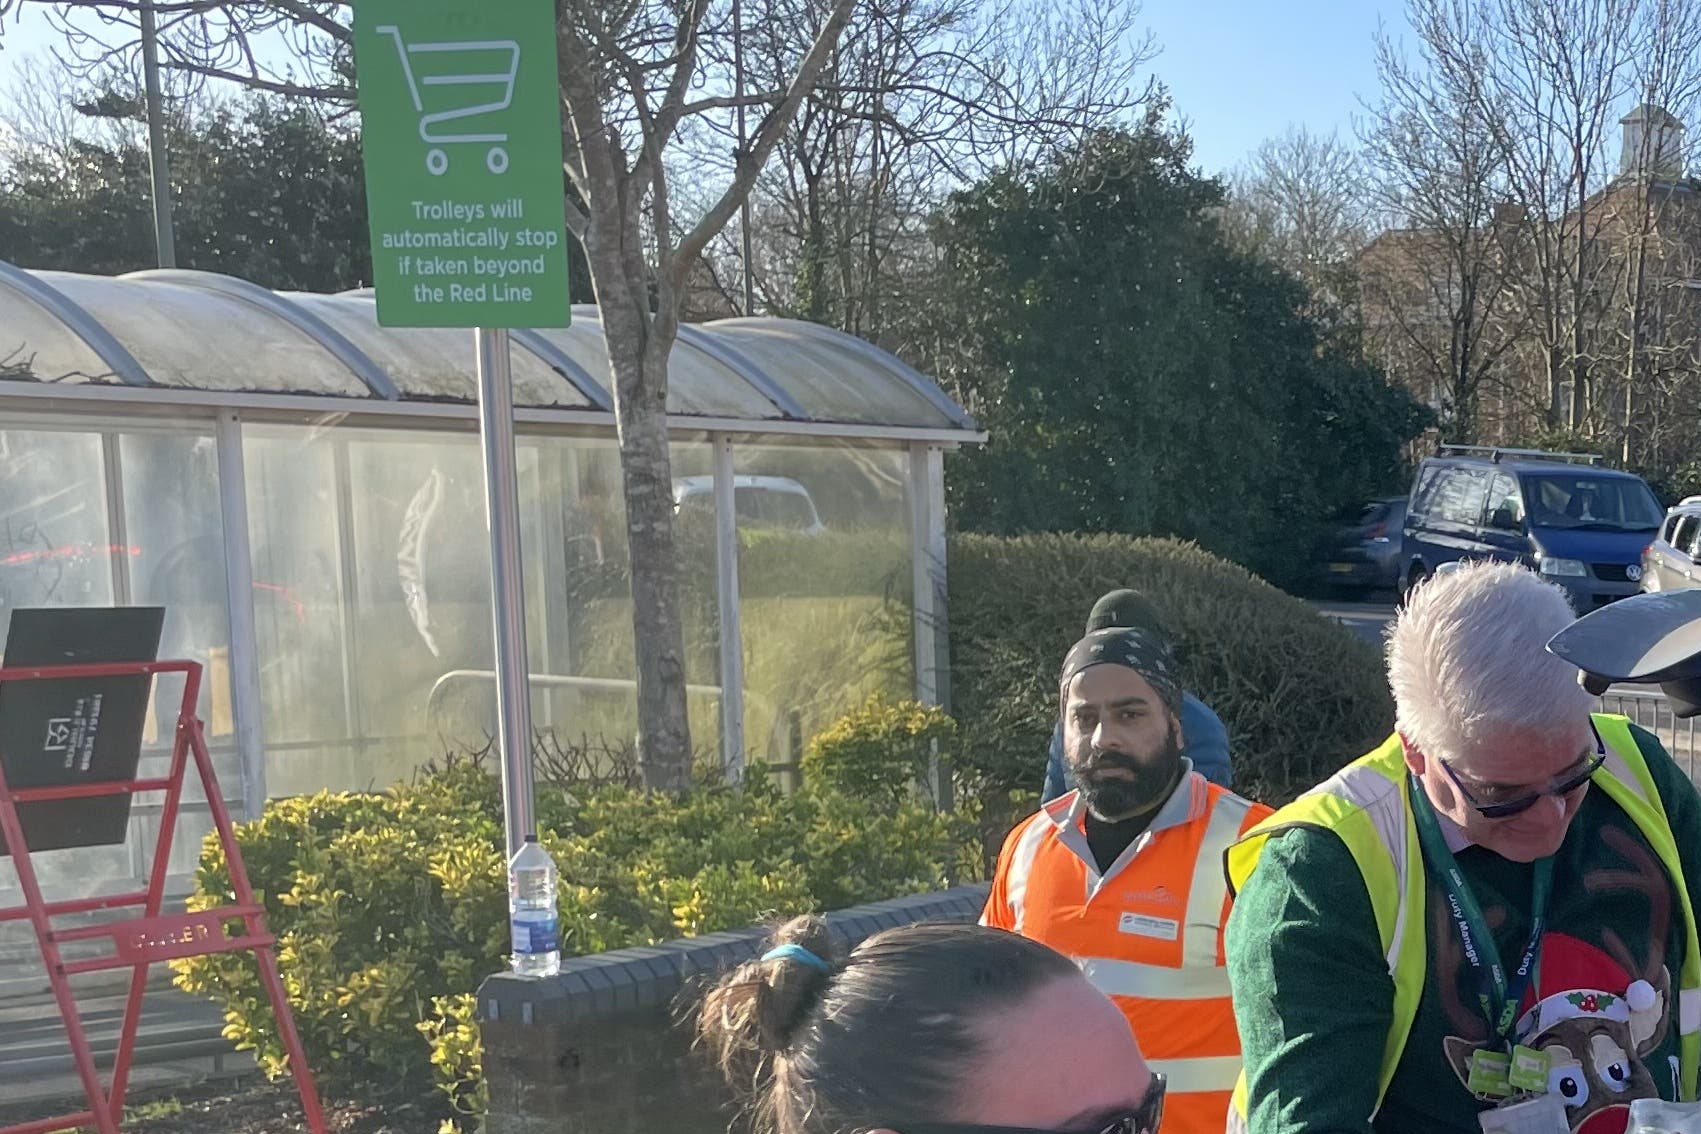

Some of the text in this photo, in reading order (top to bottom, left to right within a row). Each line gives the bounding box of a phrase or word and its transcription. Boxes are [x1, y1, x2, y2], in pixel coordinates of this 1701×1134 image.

[411, 198, 523, 223] Trolleys will
[382, 227, 558, 250] automatically stop
[399, 254, 545, 278] if taken beyond
[414, 282, 533, 302] the Red Line
[1458, 920, 1480, 968] Manager
[1517, 952, 1534, 976] Duty
